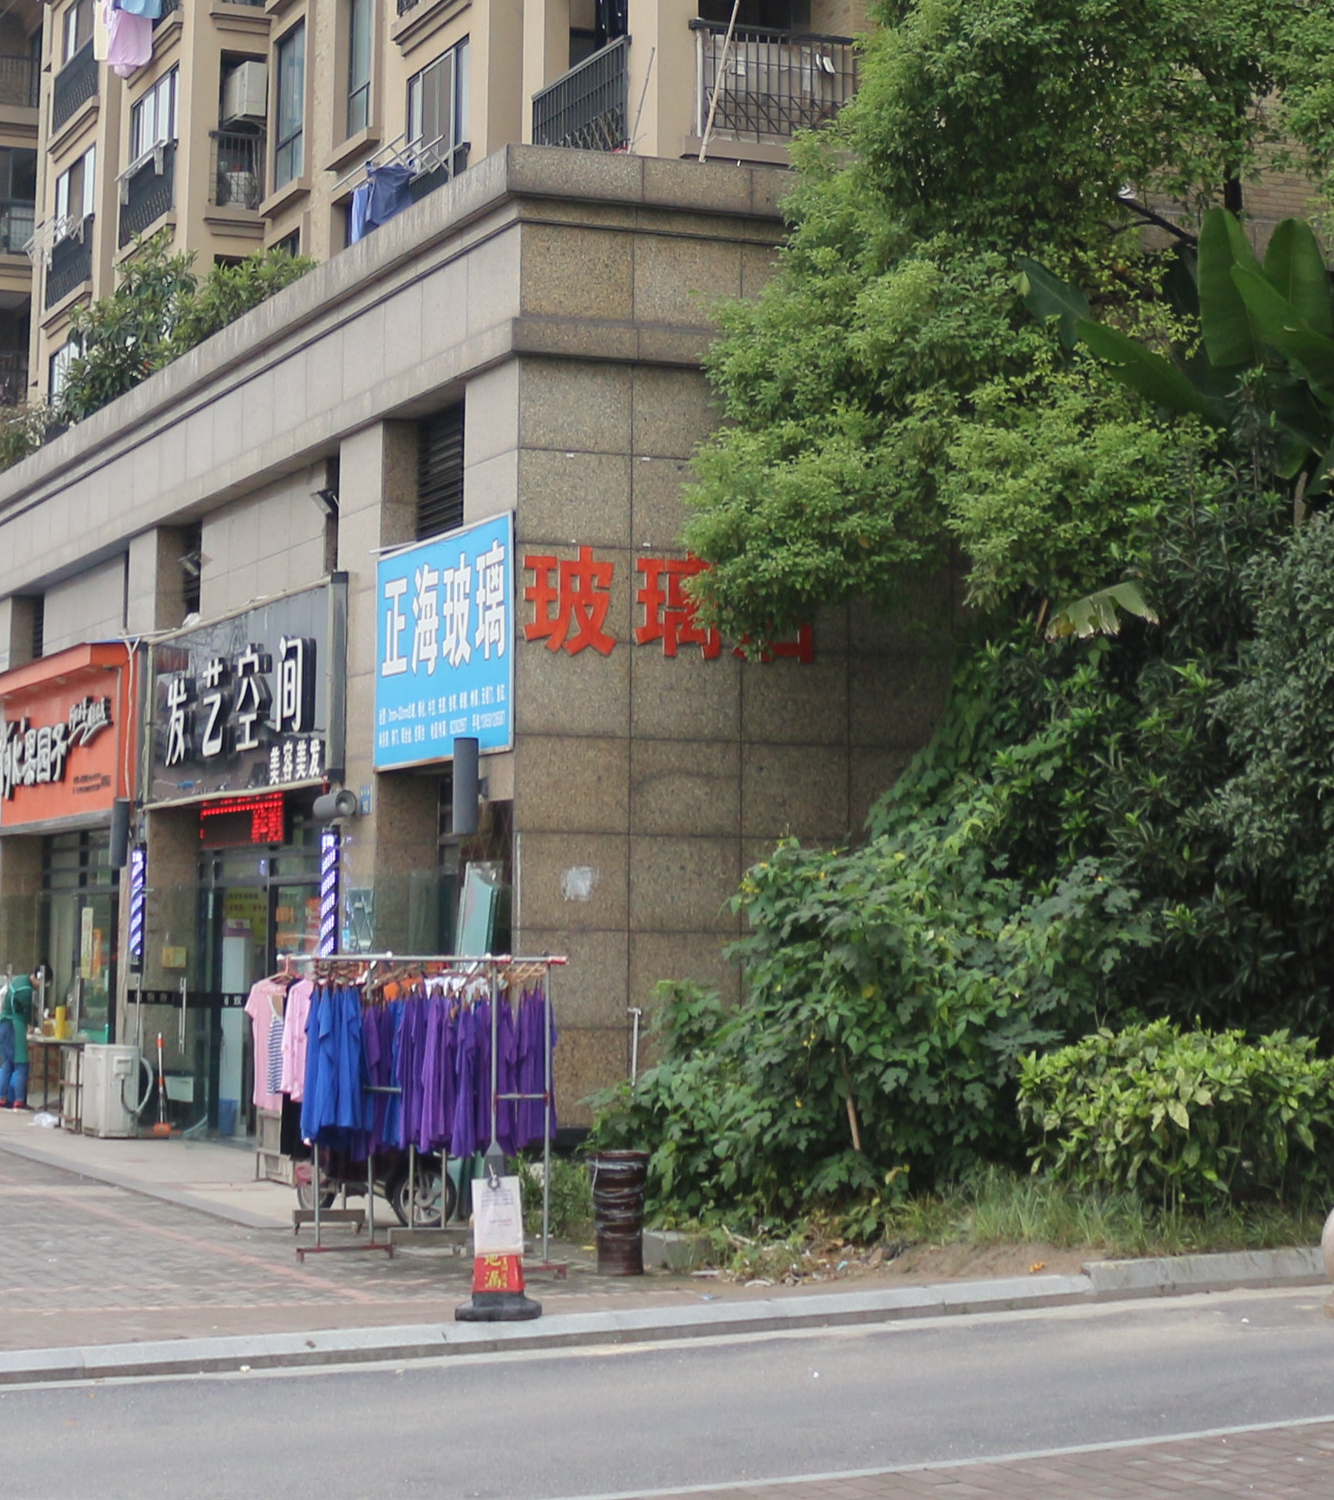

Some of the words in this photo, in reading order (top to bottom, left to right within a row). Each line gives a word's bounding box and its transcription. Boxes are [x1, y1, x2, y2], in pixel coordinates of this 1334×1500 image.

[381, 539, 505, 677] 正海玻璃
[523, 545, 813, 663] 玻璃
[165, 635, 307, 767] 发艺空间
[269, 739, 321, 785] 美容美发
